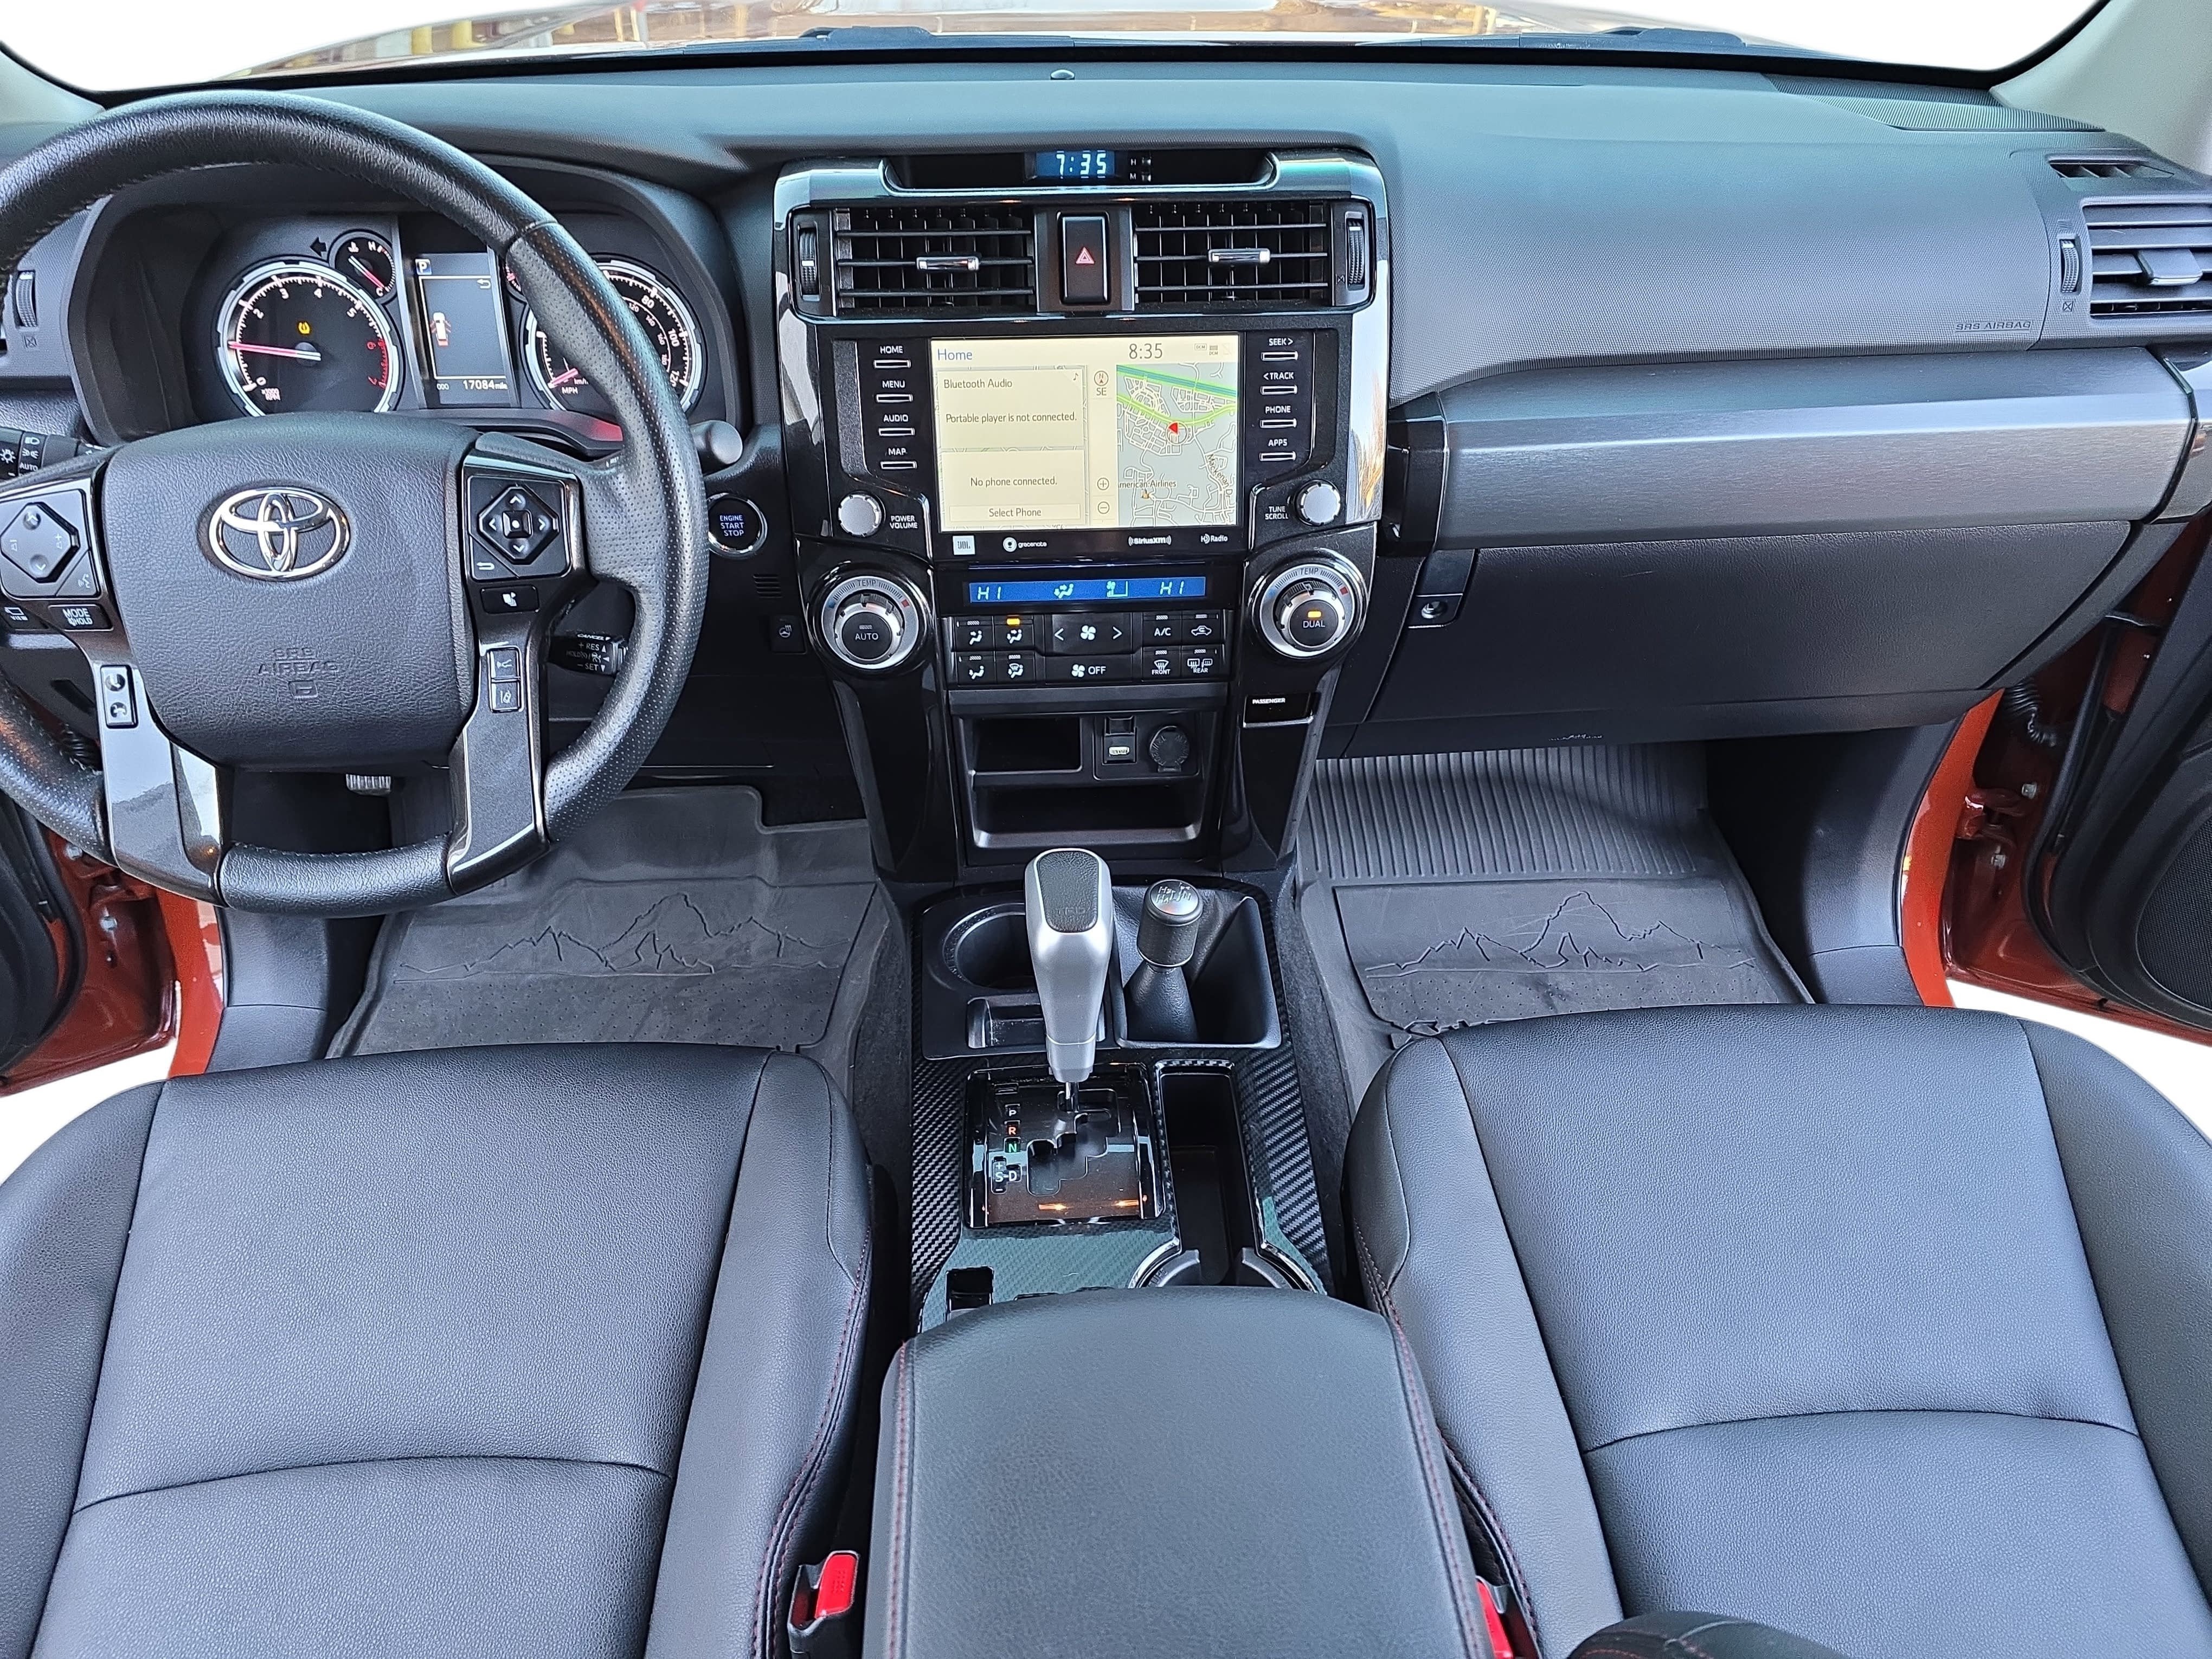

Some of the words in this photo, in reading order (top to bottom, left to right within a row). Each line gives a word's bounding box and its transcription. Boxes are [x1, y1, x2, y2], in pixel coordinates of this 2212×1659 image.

[1056, 153, 1107, 176] 7:35
[368, 241, 376, 251] H
[418, 261, 428, 273] P
[279, 288, 289, 299] 3
[314, 288, 323, 298] 4
[641, 295, 654, 308] 80
[346, 308, 357, 318] 5
[629, 303, 639, 313] 120
[253, 308, 264, 319] 2
[646, 316, 655, 326] 140
[1984, 321, 2031, 330] AIRBAG
[657, 333, 665, 345] 160
[668, 328, 680, 347] 100
[367, 342, 376, 350] 6
[880, 345, 904, 354] HOME
[1129, 343, 1163, 359] 8:35
[937, 349, 973, 361] Home
[256, 377, 266, 385] 0
[463, 380, 495, 390] 17084
[882, 380, 905, 389] MENU
[943, 379, 985, 389] Bluetooth
[987, 378, 1013, 388] Audio
[1096, 387, 1107, 396] SE
[1265, 406, 1291, 414] PHONE
[883, 414, 909, 422] AUDIO
[946, 413, 979, 423] Portable
[981, 413, 1006, 425] player
[1008, 413, 1015, 422] is
[1016, 414, 1030, 422] not
[1032, 411, 1077, 422] connected.
[1268, 439, 1288, 447] APPS
[888, 447, 906, 456] MAP
[19, 462, 38, 472] AUTO
[970, 477, 983, 487] No
[985, 477, 1011, 488] phone
[1013, 476, 1058, 486] connected.
[1117, 480, 1148, 488] merican
[1150, 480, 1176, 488] Airlines
[989, 508, 1013, 517] Select
[1016, 507, 1041, 517] Phone
[1265, 512, 1289, 520] SCROLL
[890, 522, 918, 530] VOLUME
[1211, 534, 1228, 542] Radio
[1301, 568, 1319, 576] TEMP
[857, 579, 877, 587] TEMP
[1159, 581, 1184, 595] HI
[977, 586, 1002, 600] HI
[62, 608, 91, 618] MODE
[1303, 620, 1326, 628] DUAL
[855, 632, 879, 641] AUTO
[1154, 627, 1172, 637] A/C
[1088, 666, 1107, 675] OFF
[1008, 1127, 1017, 1135] R
[1008, 1143, 1017, 1153] N
